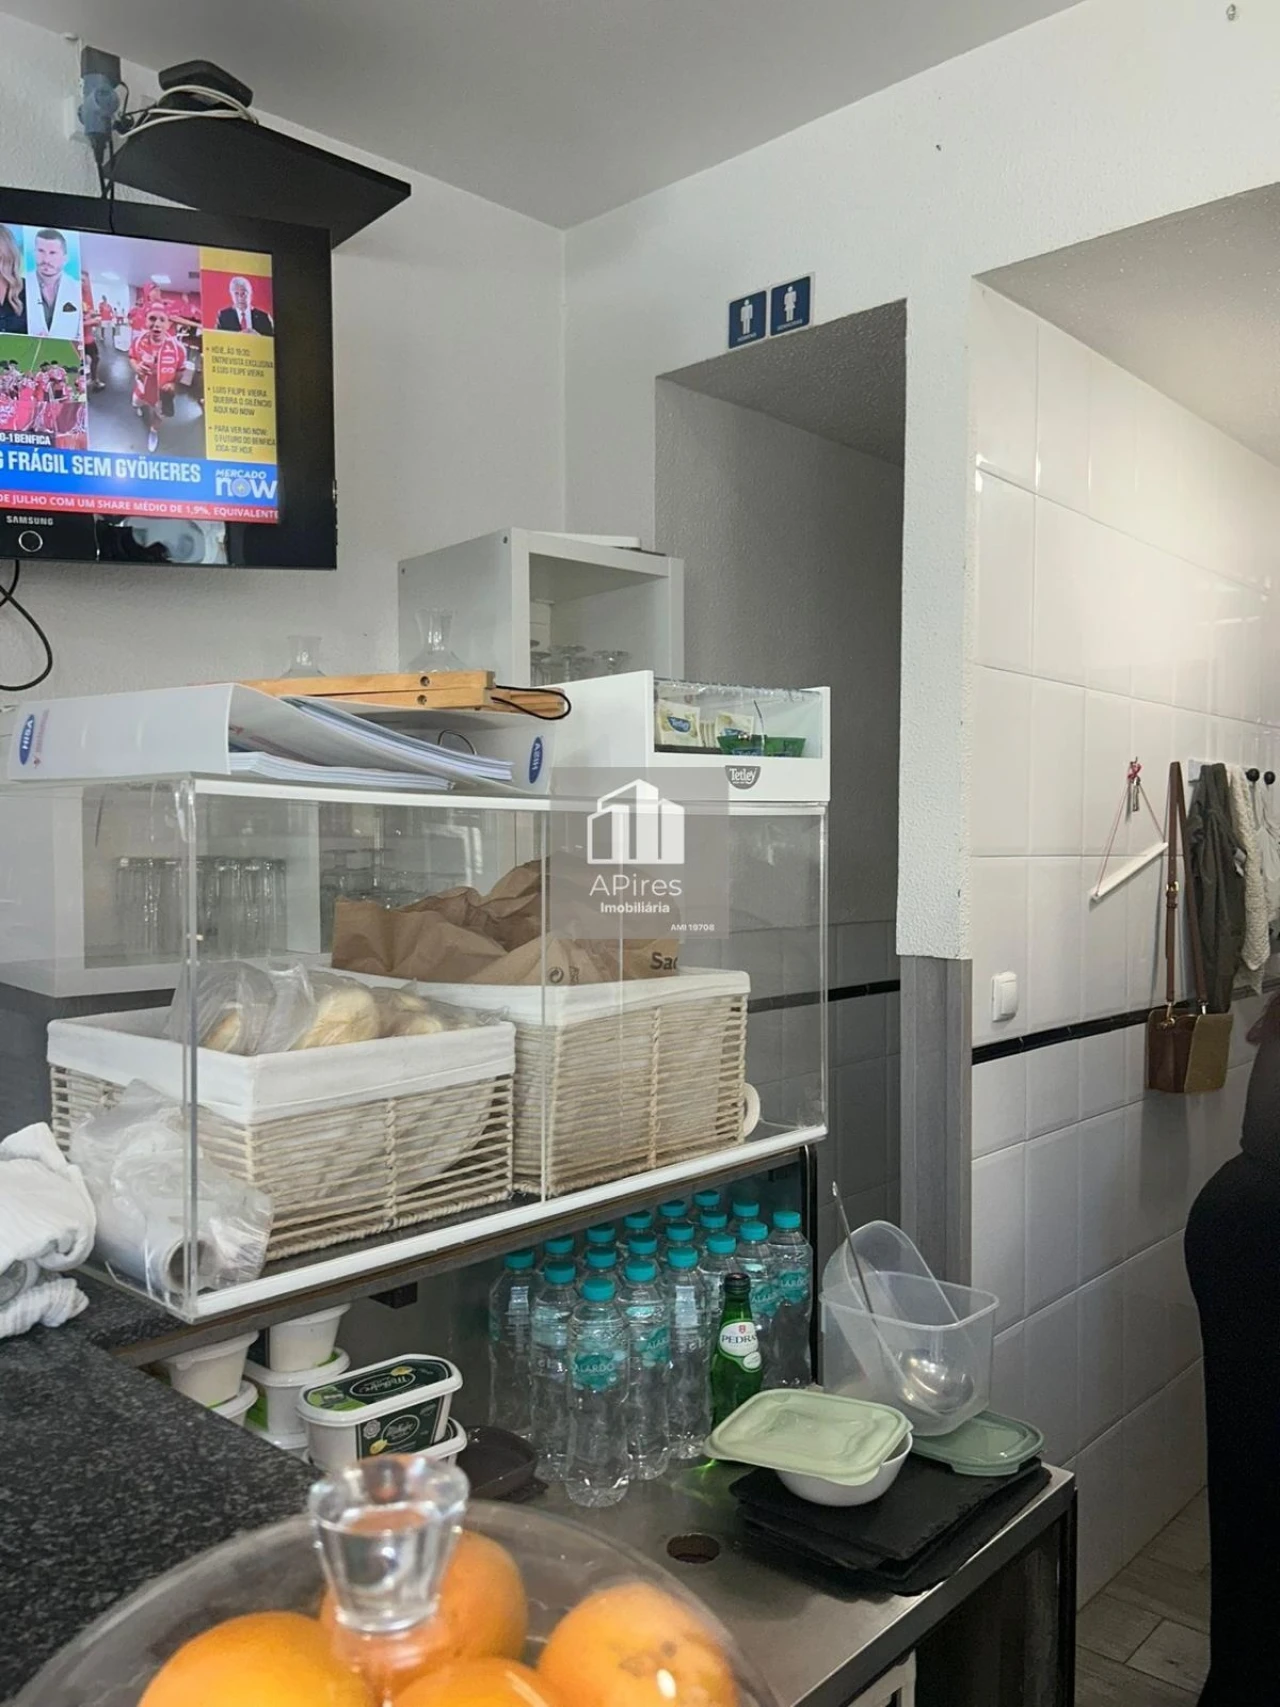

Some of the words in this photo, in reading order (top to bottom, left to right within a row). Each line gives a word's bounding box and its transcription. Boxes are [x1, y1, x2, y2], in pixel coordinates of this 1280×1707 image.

[211, 356, 244, 365] ENTREVISTA
[230, 367, 246, 376] FILIPE
[247, 369, 265, 377] VIEIRA
[227, 387, 246, 396] FILIPE
[247, 389, 267, 397] VIEIRA
[212, 396, 238, 404] QUEBRA
[213, 406, 228, 414] AQUI
[229, 407, 238, 415] NO
[214, 425, 230, 433] PARA
[230, 426, 242, 434] VER
[15, 433, 52, 446] BENFICA
[219, 435, 242, 443] FUTURO
[243, 436, 251, 444] DO
[252, 437, 276, 446] BENFICA
[8, 447, 69, 475] FRÁGIL
[71, 455, 112, 477] SEM
[115, 456, 202, 483] GYÖKERES
[215, 468, 267, 480] MERCADO
[12, 494, 47, 505] JULHO
[50, 496, 75, 507] COM
[77, 498, 95, 509] UM
[97, 500, 130, 510] SHARE
[133, 500, 167, 512] MÉDIO
[169, 503, 182, 513] DE
[6, 515, 54, 526] SAMSUNG
[728, 767, 758, 784] Tetley
